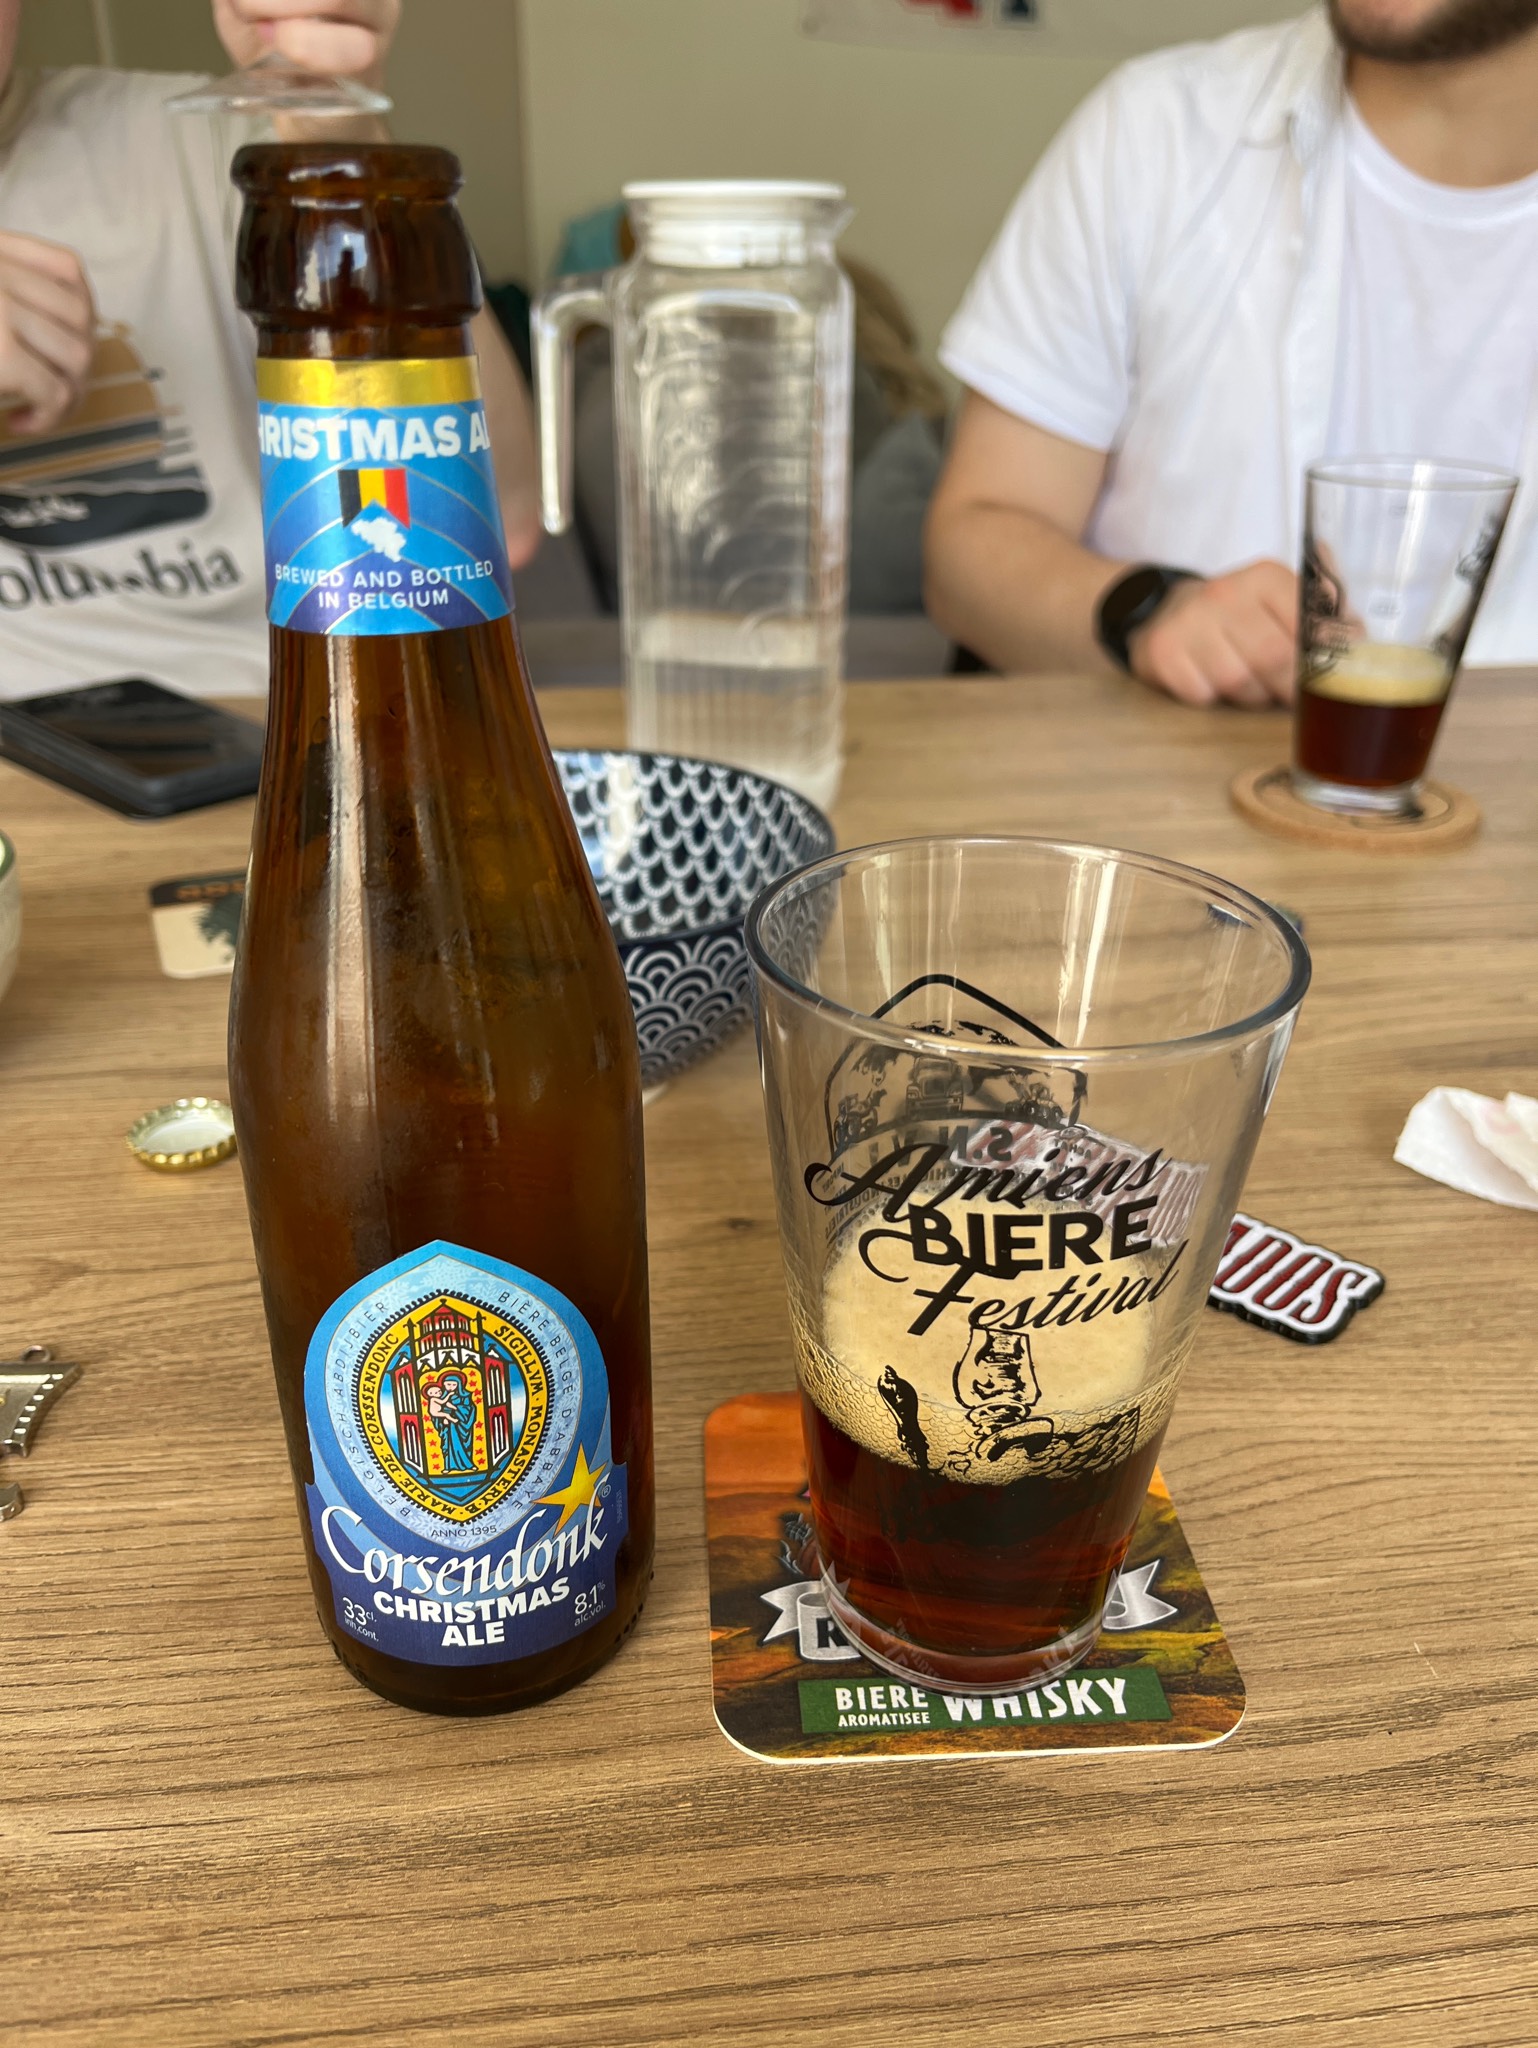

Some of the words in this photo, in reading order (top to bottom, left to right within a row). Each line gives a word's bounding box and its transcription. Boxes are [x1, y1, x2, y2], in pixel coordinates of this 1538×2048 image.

[275, 563, 344, 587] BREWED
[353, 571, 402, 588] AND
[411, 560, 493, 586] BOTTLED
[319, 592, 340, 609] IN
[349, 589, 449, 610] BELGIUM
[804, 1143, 1173, 1223] Amiens
[908, 1195, 1158, 1276] BIERE
[858, 1229, 1189, 1336] Festival
[333, 1302, 390, 1400] ABDIJBIER
[493, 1325, 544, 1396] SIGILLVM
[498, 1291, 550, 1331] BIÈRE
[550, 1335, 573, 1396] BELGE
[362, 1333, 399, 1446] CORSSENDONC
[337, 1413, 411, 1518] BELGISCH
[380, 1453, 401, 1474] DE
[400, 1477, 457, 1515] MARIE
[321, 1472, 610, 1596] Corsendonk
[430, 1529, 467, 1538] ANNO
[471, 1525, 497, 1535] 1395
[373, 1576, 570, 1624] CHRISTMAS
[441, 1621, 505, 1648] ALE
[835, 1684, 929, 1710] BIERE
[941, 1677, 1127, 1722] WHISKY
[838, 1711, 931, 1728] AROMATISEE
